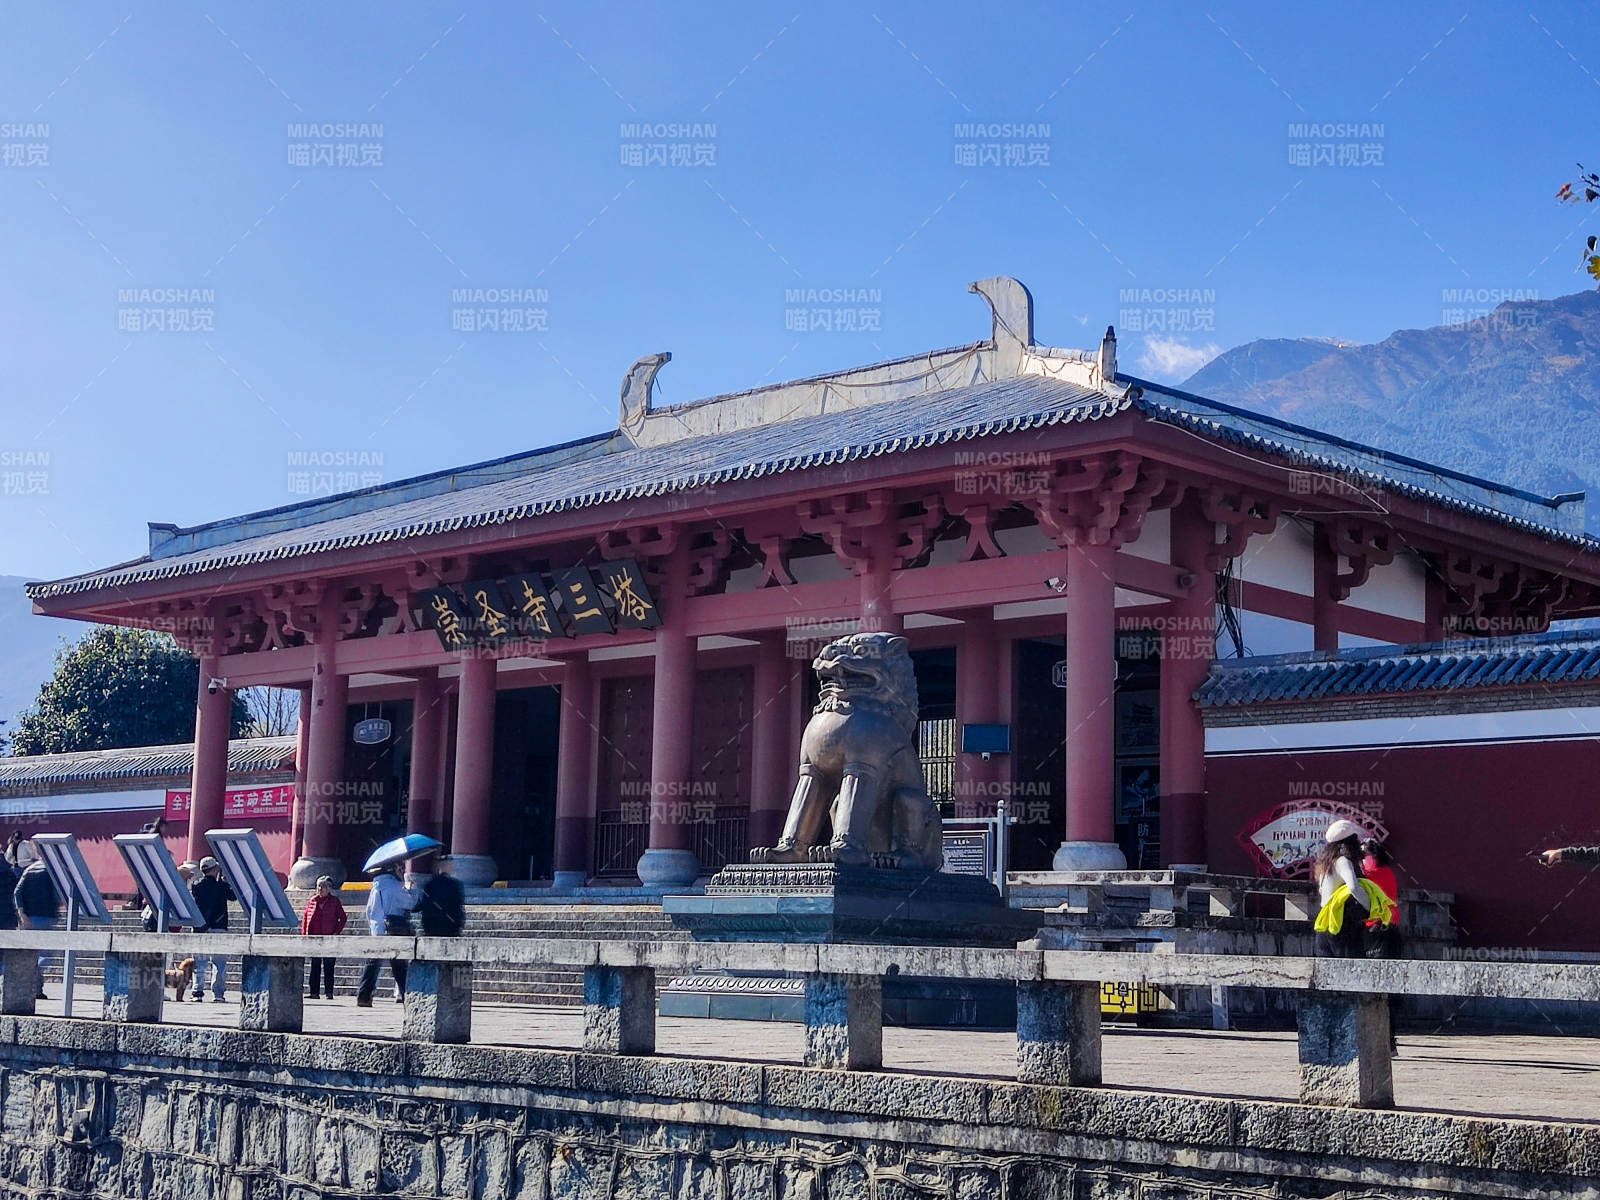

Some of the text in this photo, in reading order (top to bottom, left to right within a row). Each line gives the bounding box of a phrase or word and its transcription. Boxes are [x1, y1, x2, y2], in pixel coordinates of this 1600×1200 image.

[431, 567, 653, 645] 崇圣寺三塔
[232, 788, 288, 808] 生命至上
